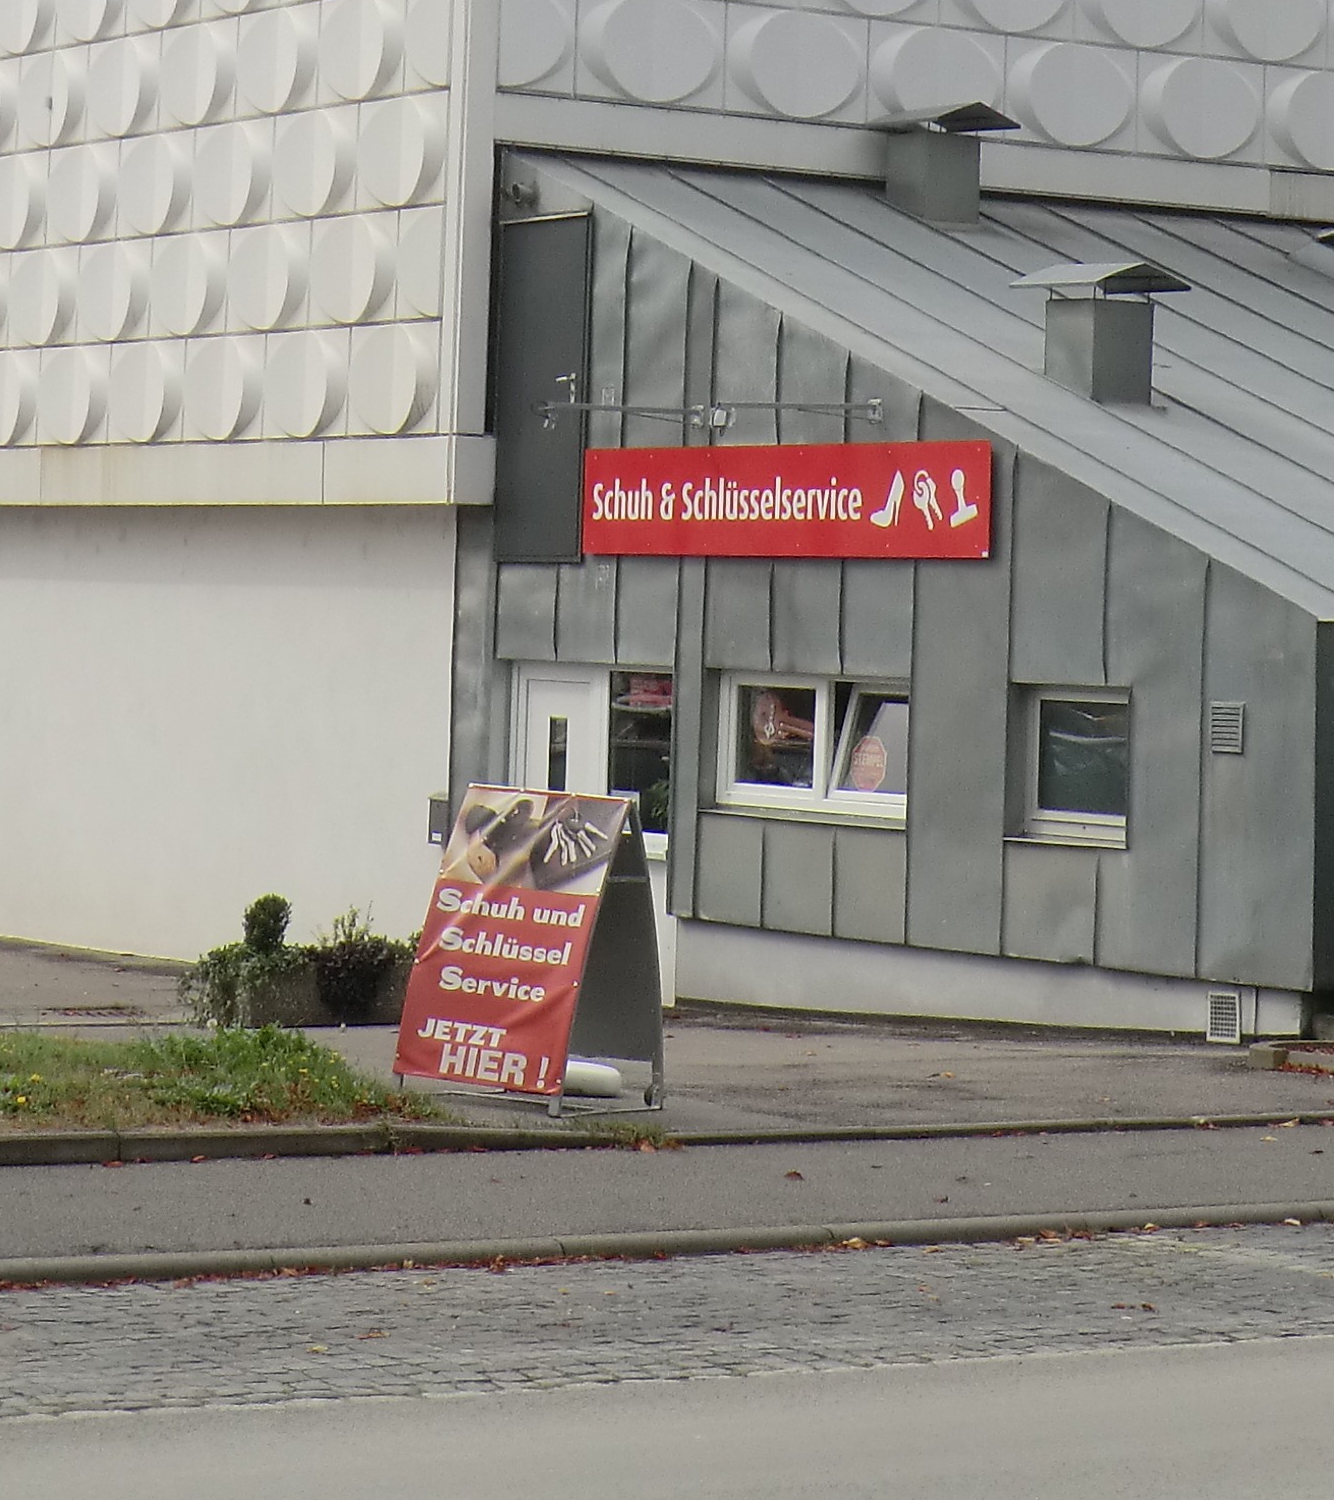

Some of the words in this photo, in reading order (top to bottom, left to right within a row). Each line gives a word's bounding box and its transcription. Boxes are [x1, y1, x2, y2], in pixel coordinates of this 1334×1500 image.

[592, 477, 653, 521] Schuh
[660, 482, 676, 521] &
[681, 476, 863, 521] Schlüsselservice
[436, 888, 526, 921] Schuh
[533, 904, 586, 927] und
[439, 926, 573, 965] Schlüssel
[439, 966, 546, 1002] Service
[417, 1017, 507, 1047] JETZT
[438, 1043, 528, 1086] HIER
